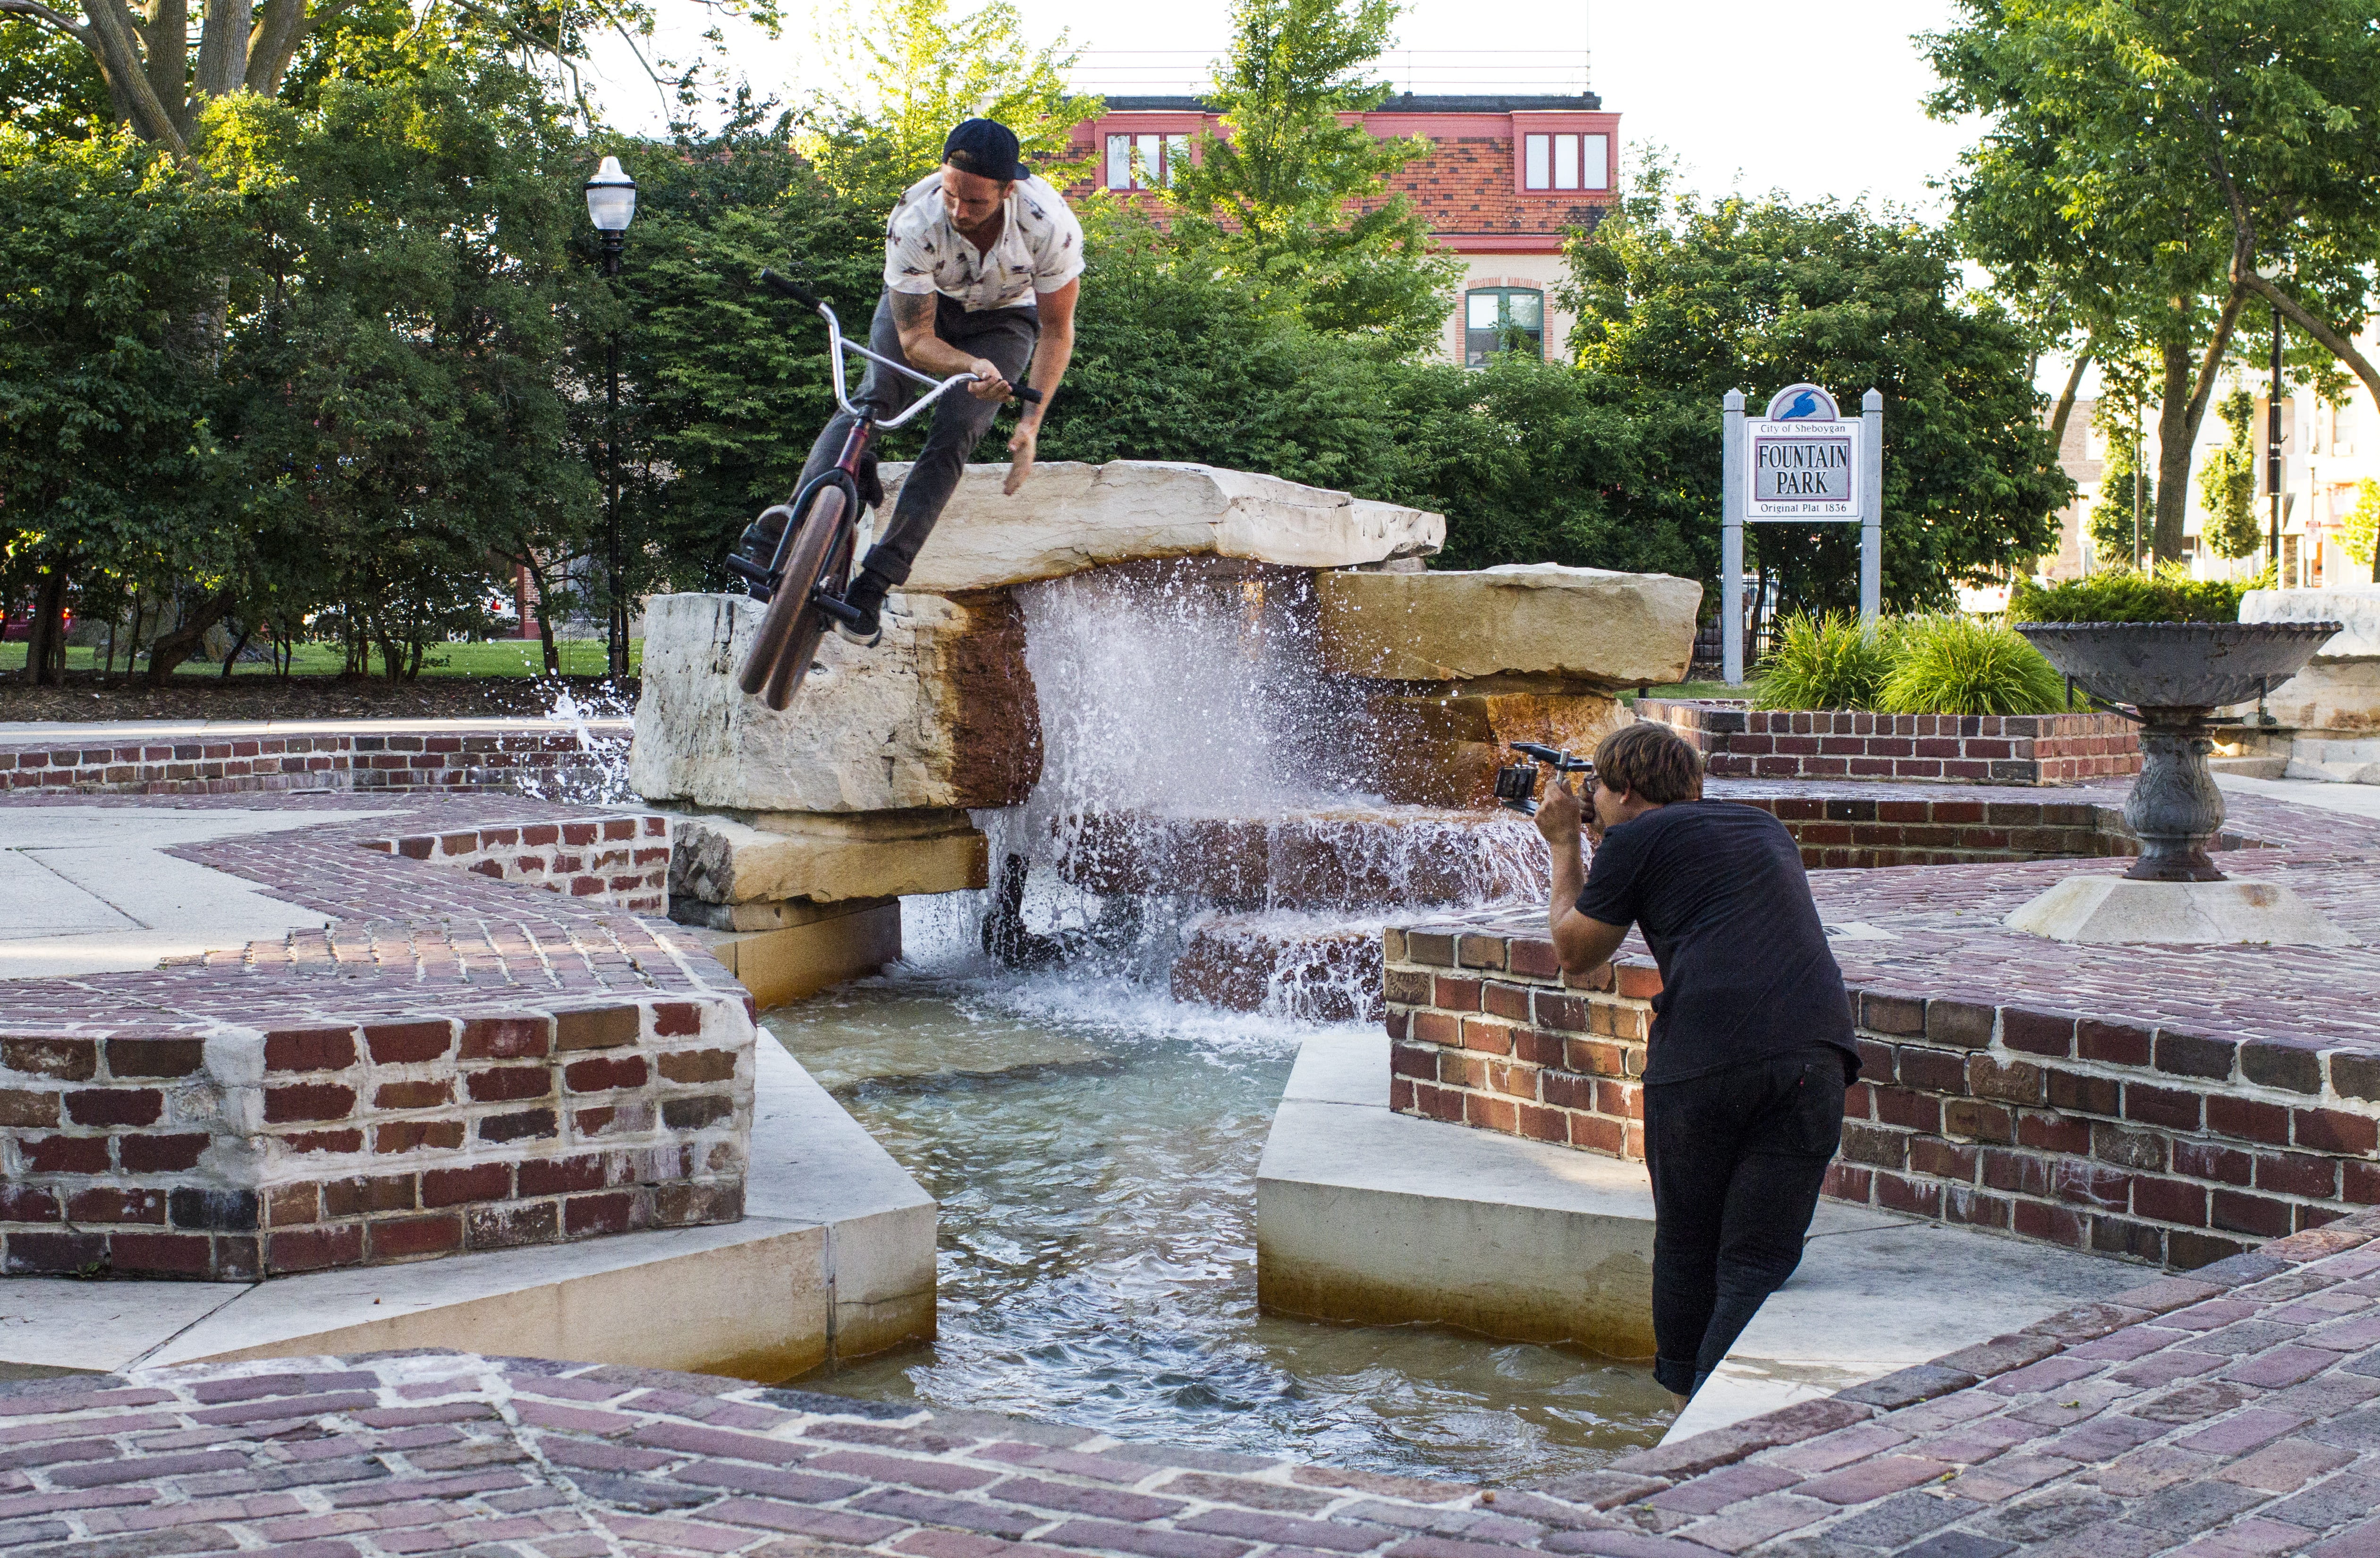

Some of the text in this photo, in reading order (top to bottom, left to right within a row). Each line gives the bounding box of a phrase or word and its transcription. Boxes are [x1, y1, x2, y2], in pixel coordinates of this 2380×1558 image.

[1761, 424, 1845, 434] City of Sheboygan
[1759, 445, 1847, 468] FOUNTAIN
[1776, 471, 1828, 494] PARK
[1761, 503, 1846, 514] Original Plat 1836
